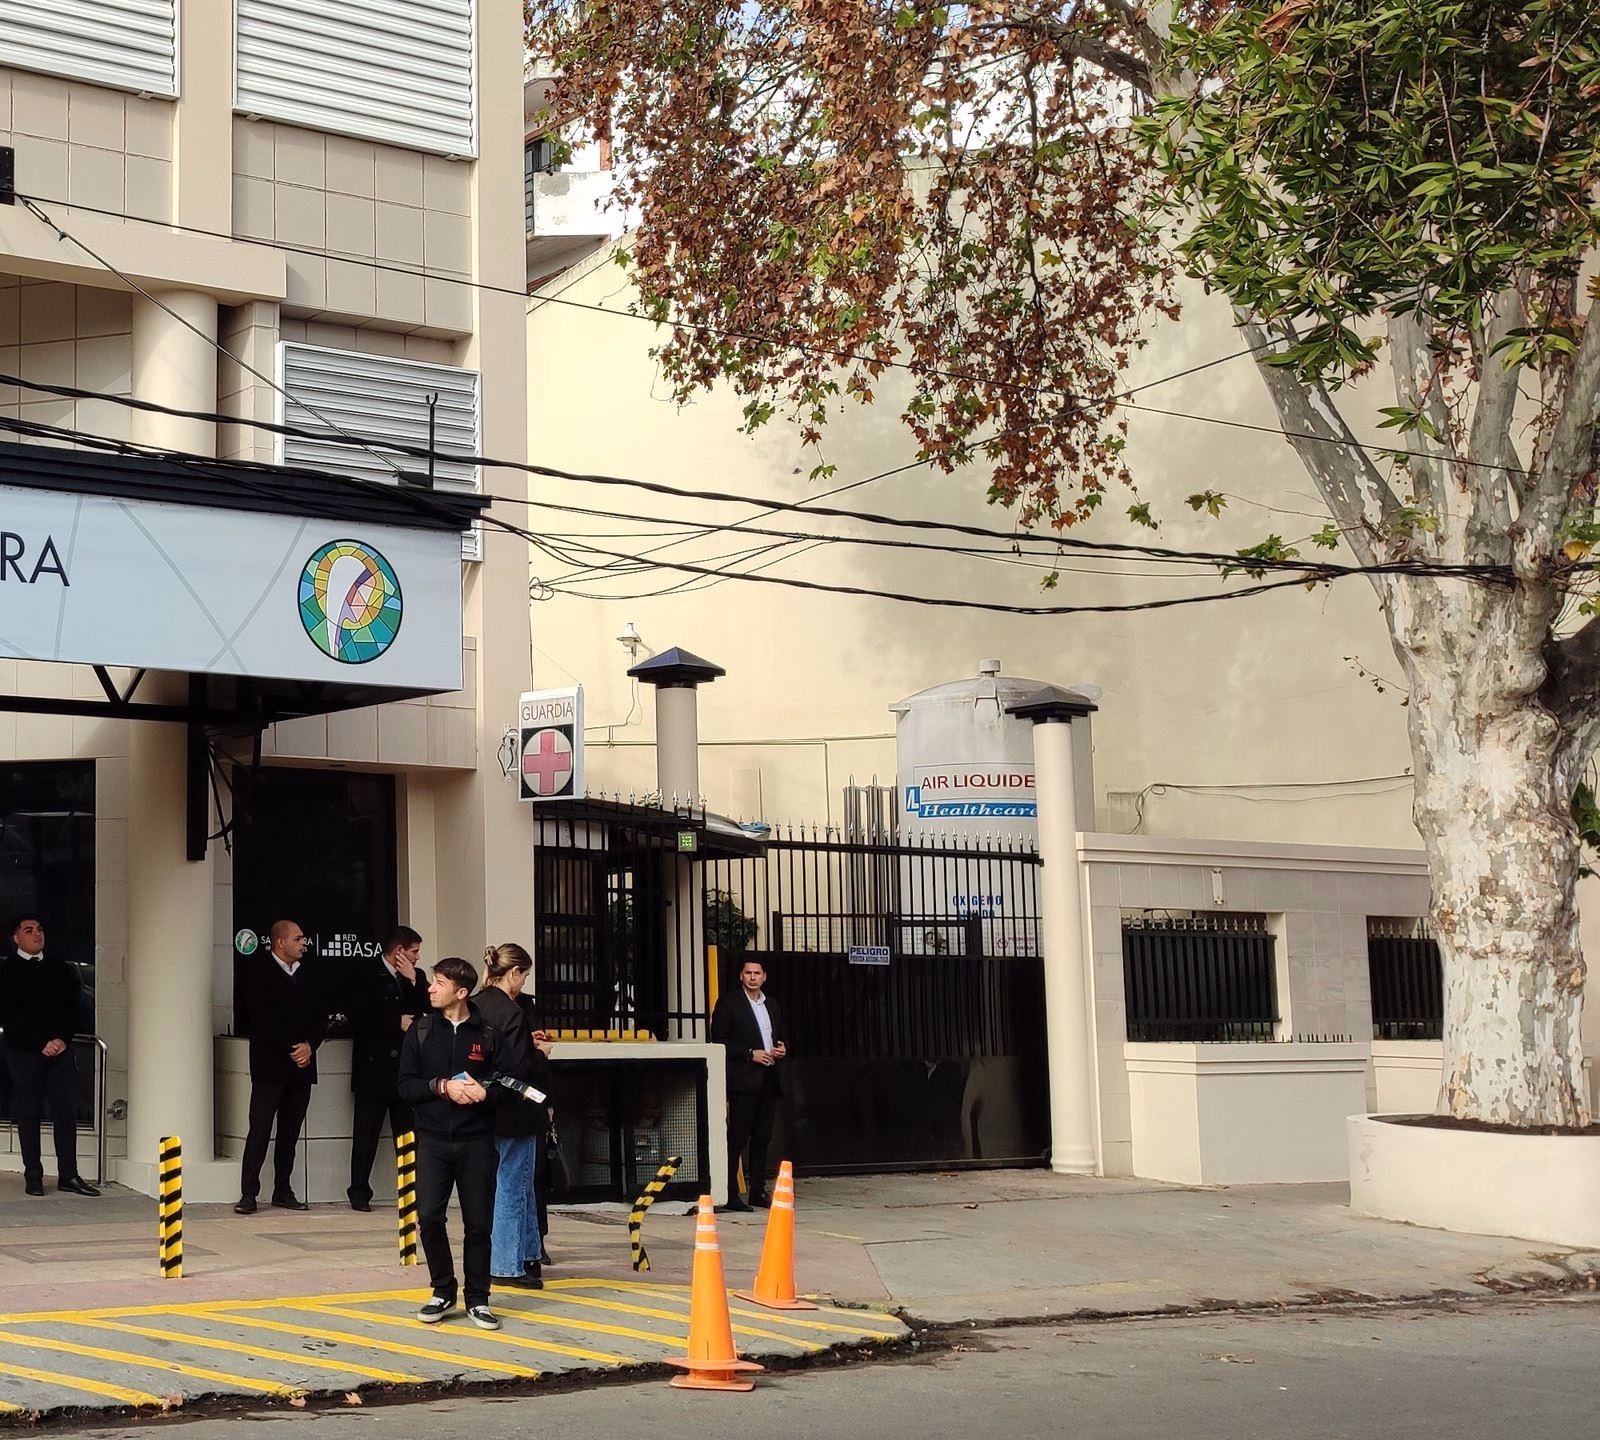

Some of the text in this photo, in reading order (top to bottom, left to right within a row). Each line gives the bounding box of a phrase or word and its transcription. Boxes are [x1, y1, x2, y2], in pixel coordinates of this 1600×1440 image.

[522, 701, 574, 721] GUARDIA
[921, 774, 1036, 790] AIR LIQUIDE
[343, 934, 357, 942] RED
[343, 942, 383, 957] BASA
[850, 947, 889, 956] PELIGRO
